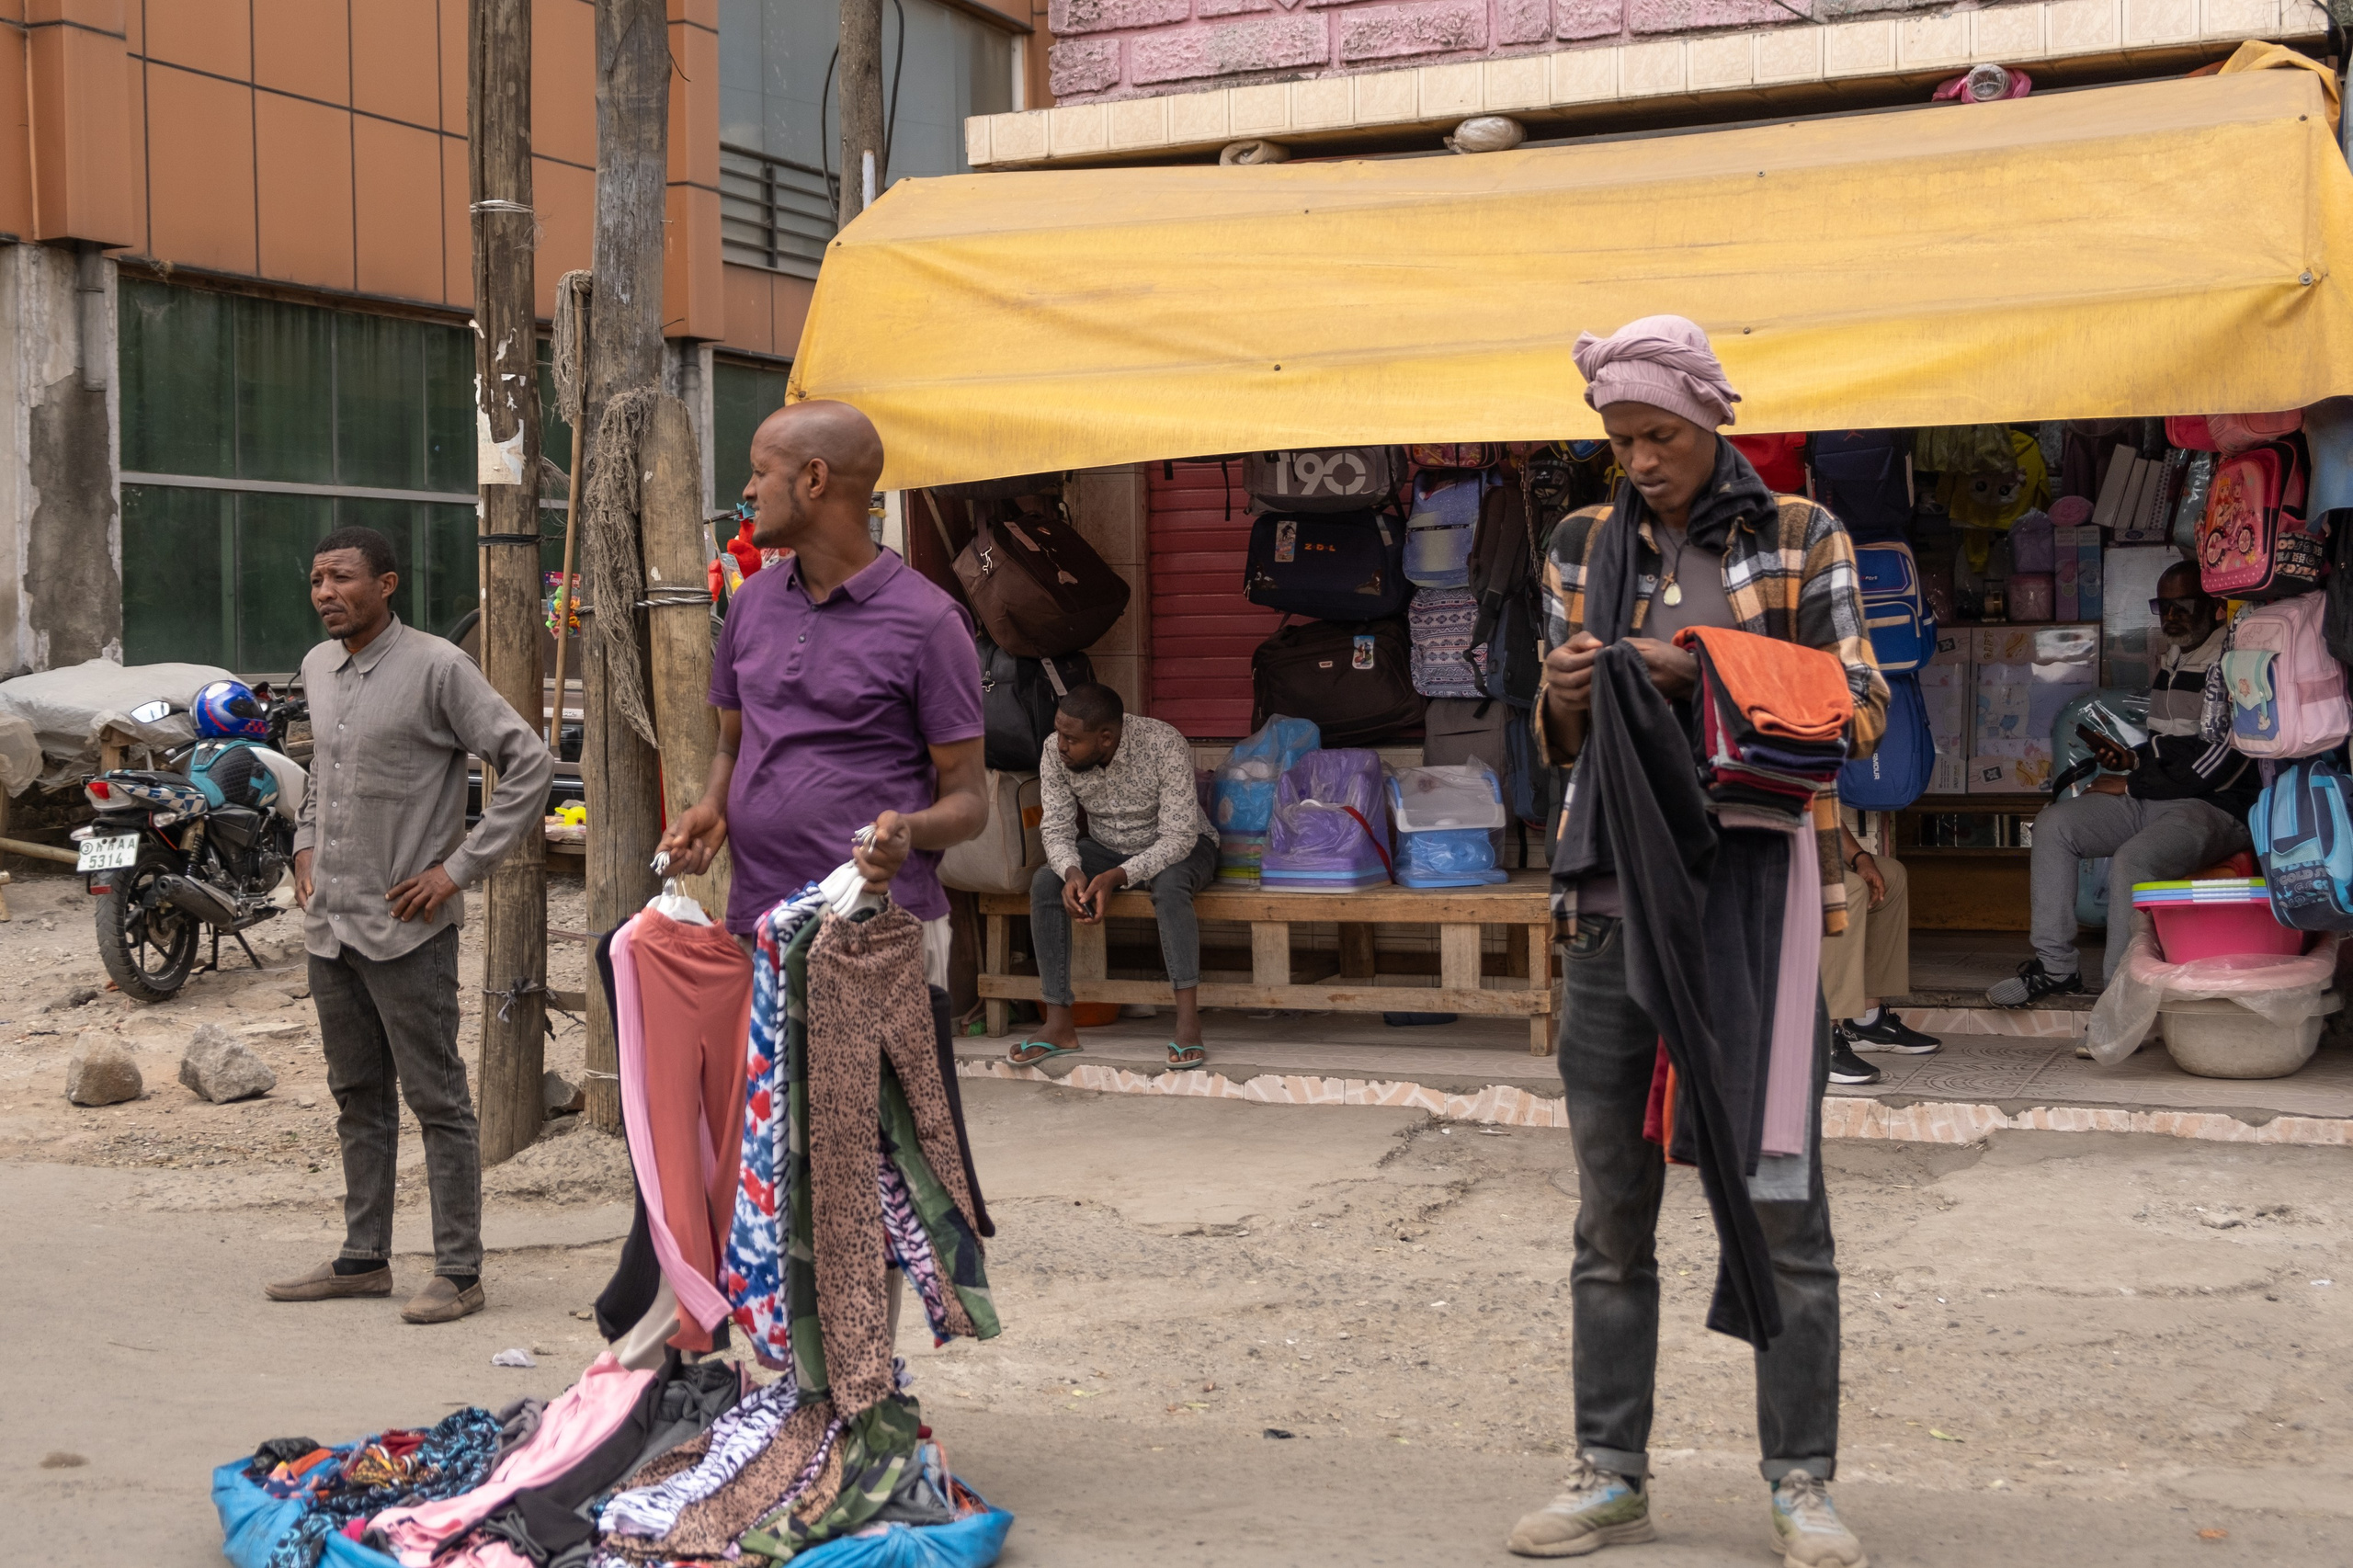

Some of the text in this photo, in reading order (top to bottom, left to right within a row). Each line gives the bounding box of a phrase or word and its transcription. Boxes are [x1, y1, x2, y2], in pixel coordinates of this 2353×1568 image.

[1983, 630, 1995, 660] GIFT
[1872, 748, 1881, 780] RMOUR
[88, 853, 123, 869] 5314
